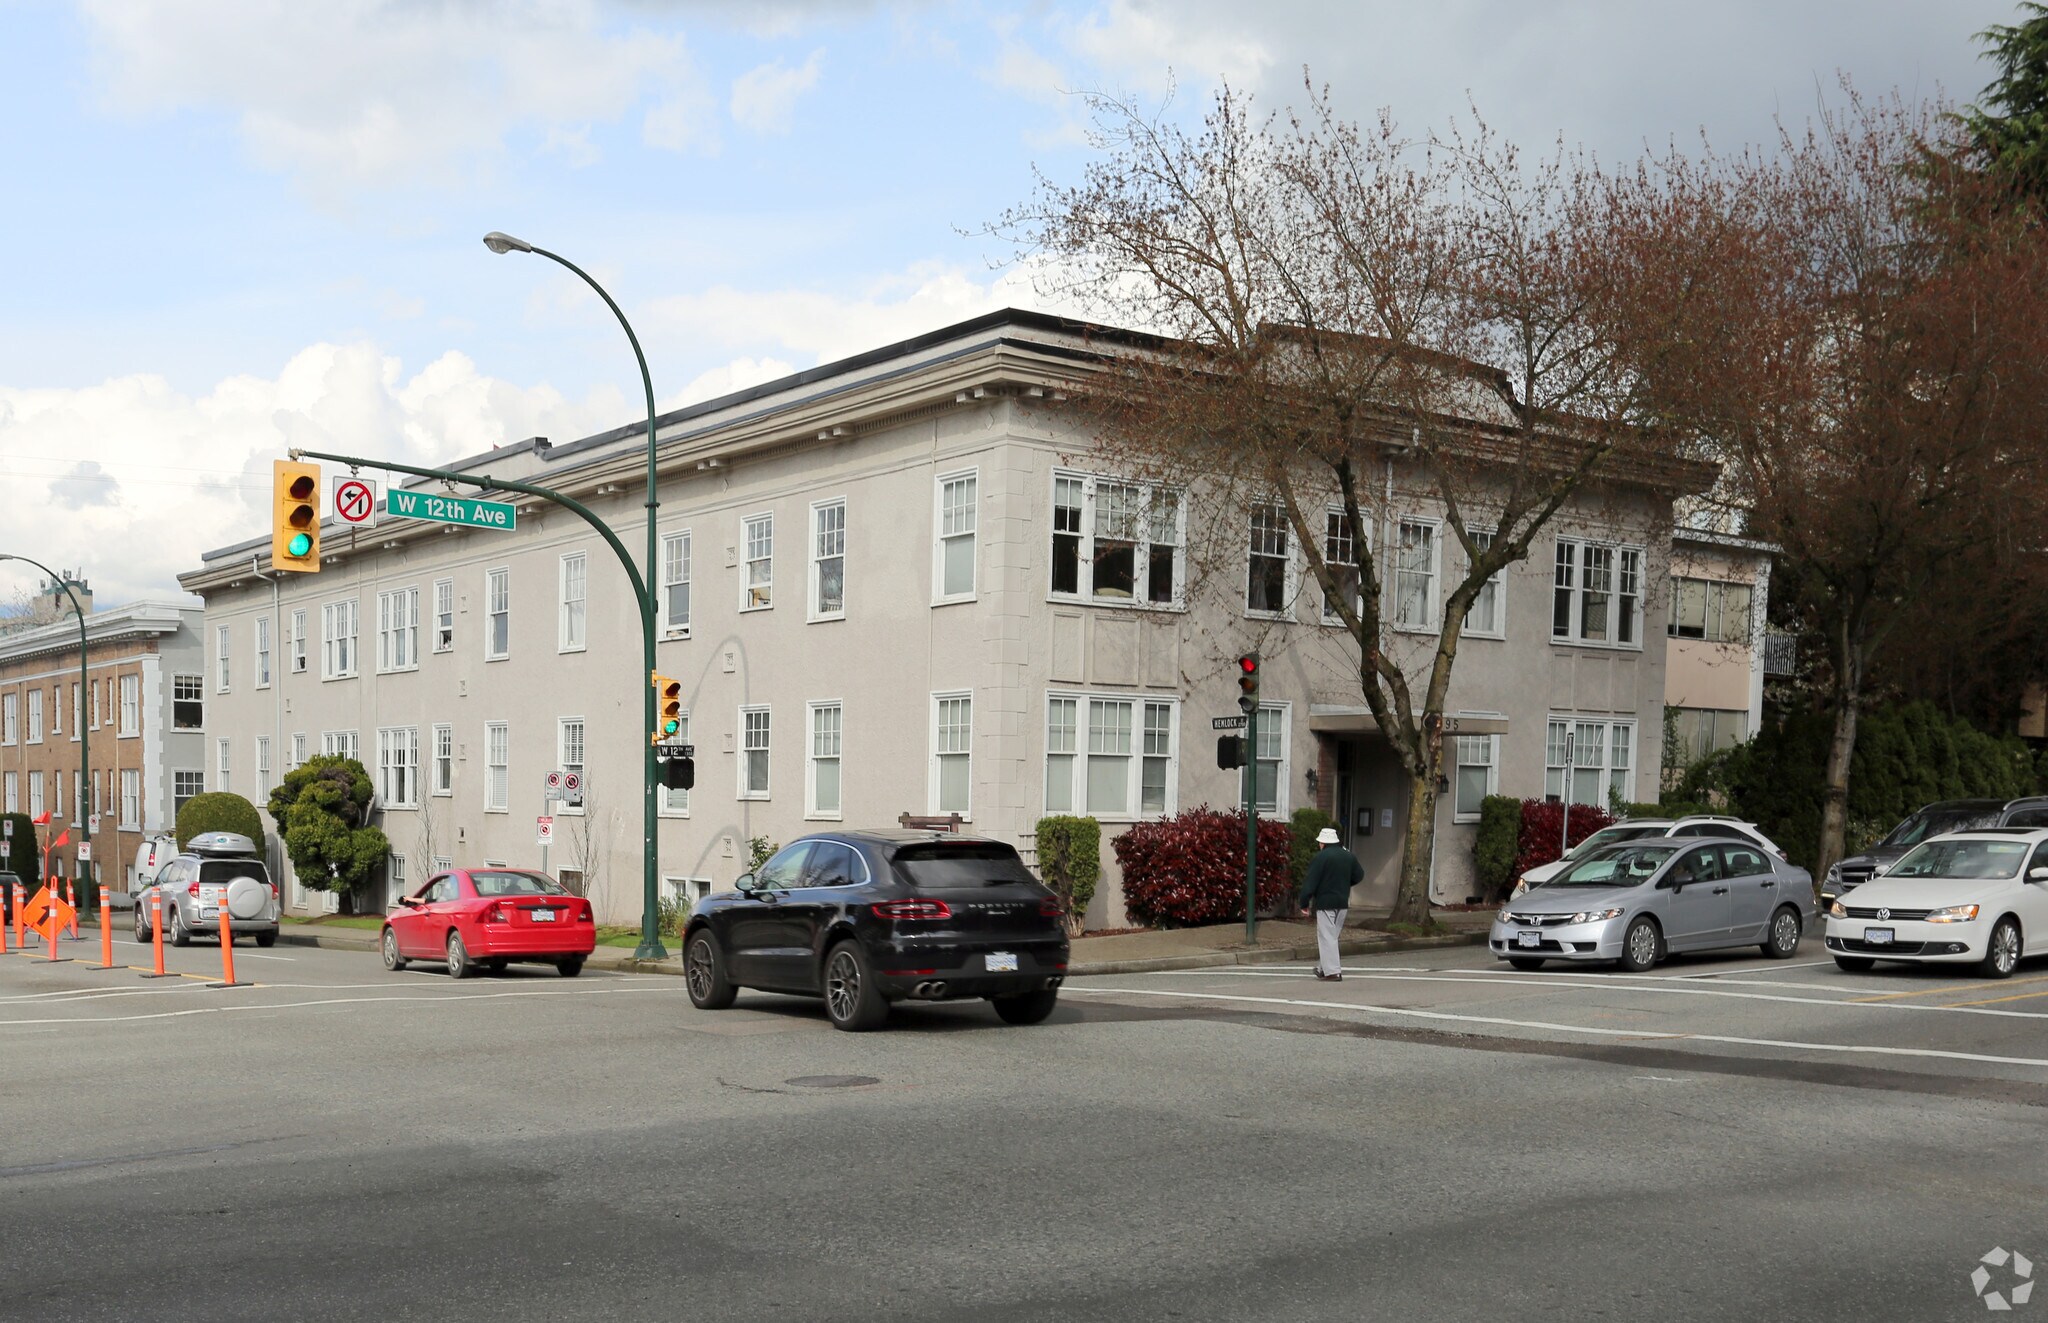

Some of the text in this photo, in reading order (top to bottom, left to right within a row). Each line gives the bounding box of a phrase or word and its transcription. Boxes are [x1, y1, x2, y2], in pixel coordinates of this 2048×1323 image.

[397, 494, 506, 525] W 12th Ave
[1214, 718, 1237, 728] HEMLOCK
[661, 746, 668, 755] W
